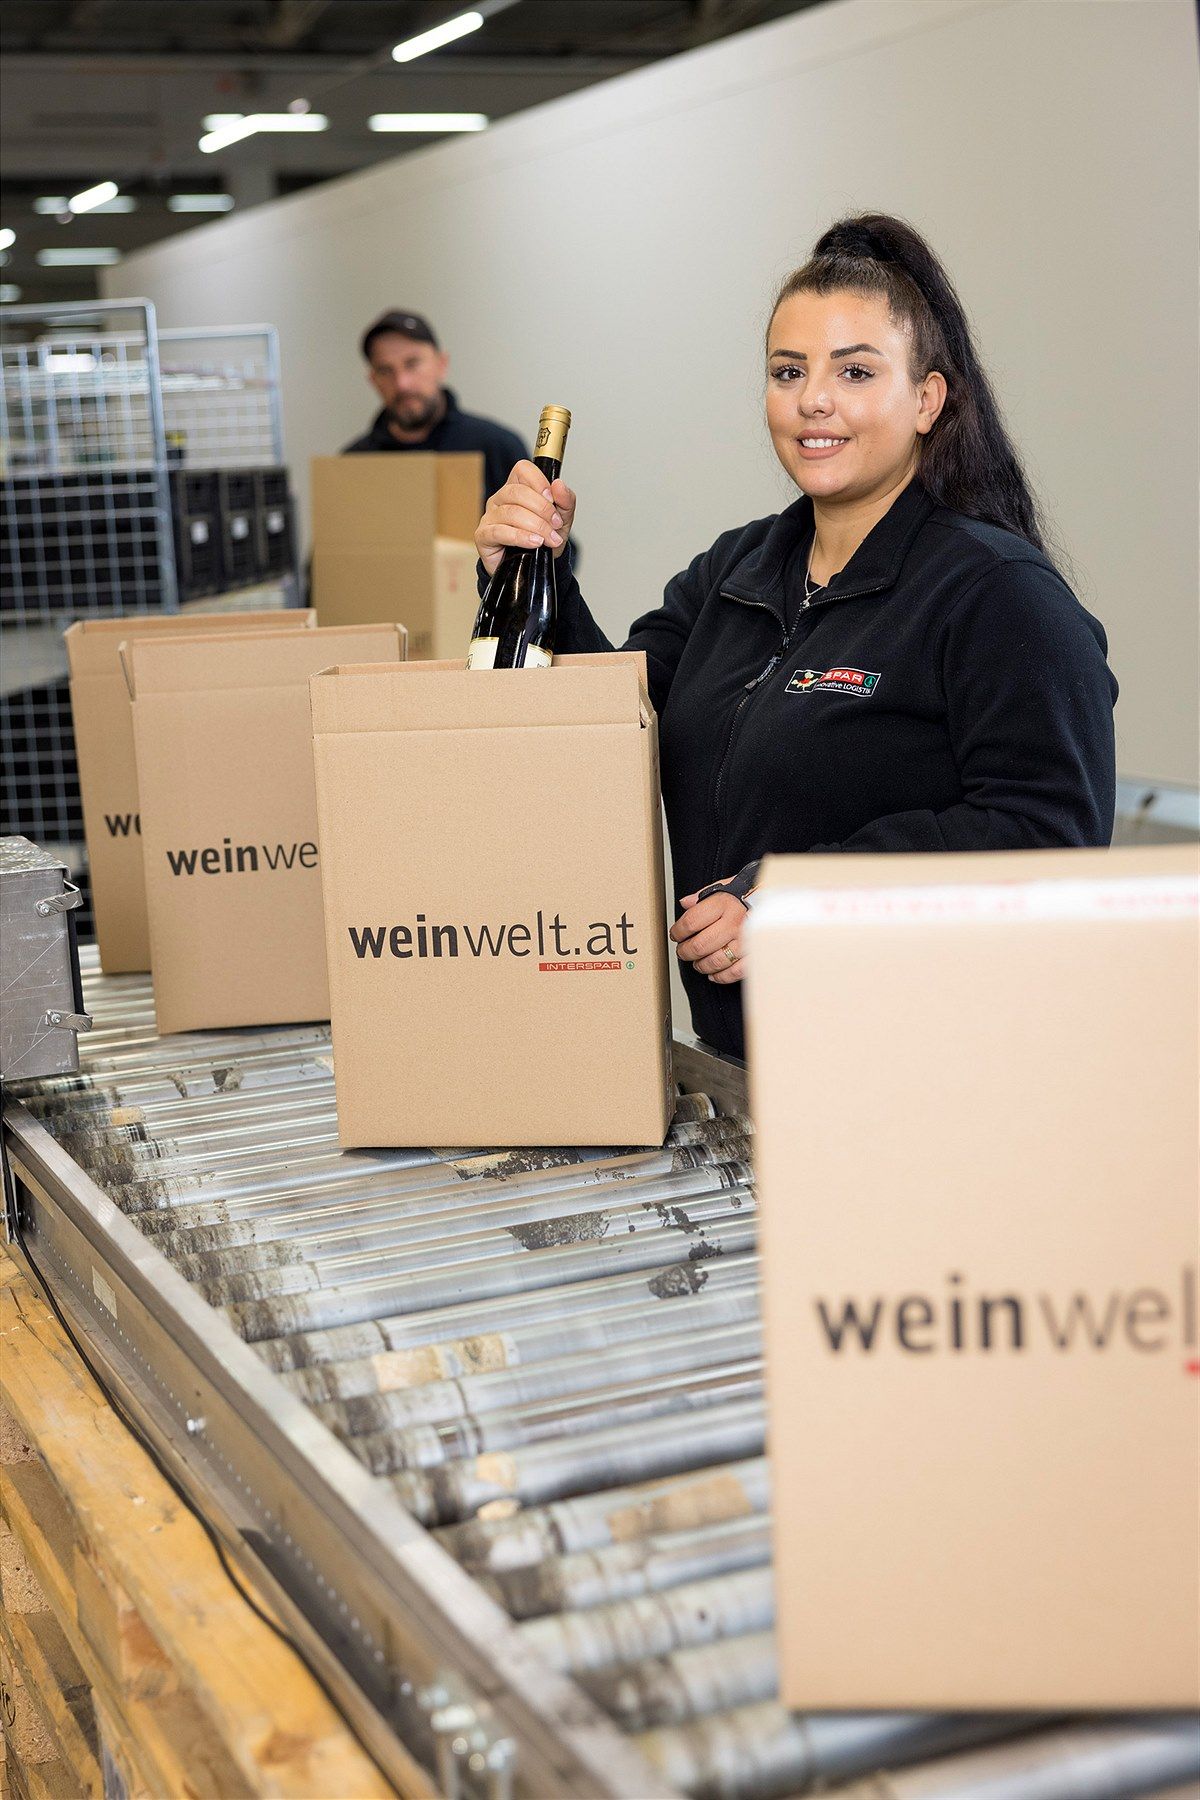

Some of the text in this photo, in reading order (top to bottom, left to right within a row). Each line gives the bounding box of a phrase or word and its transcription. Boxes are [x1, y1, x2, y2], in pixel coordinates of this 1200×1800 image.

[825, 671, 862, 682] SPAR
[347, 910, 639, 959] weinwelt.at
[546, 962, 621, 971] INTERSPAR
